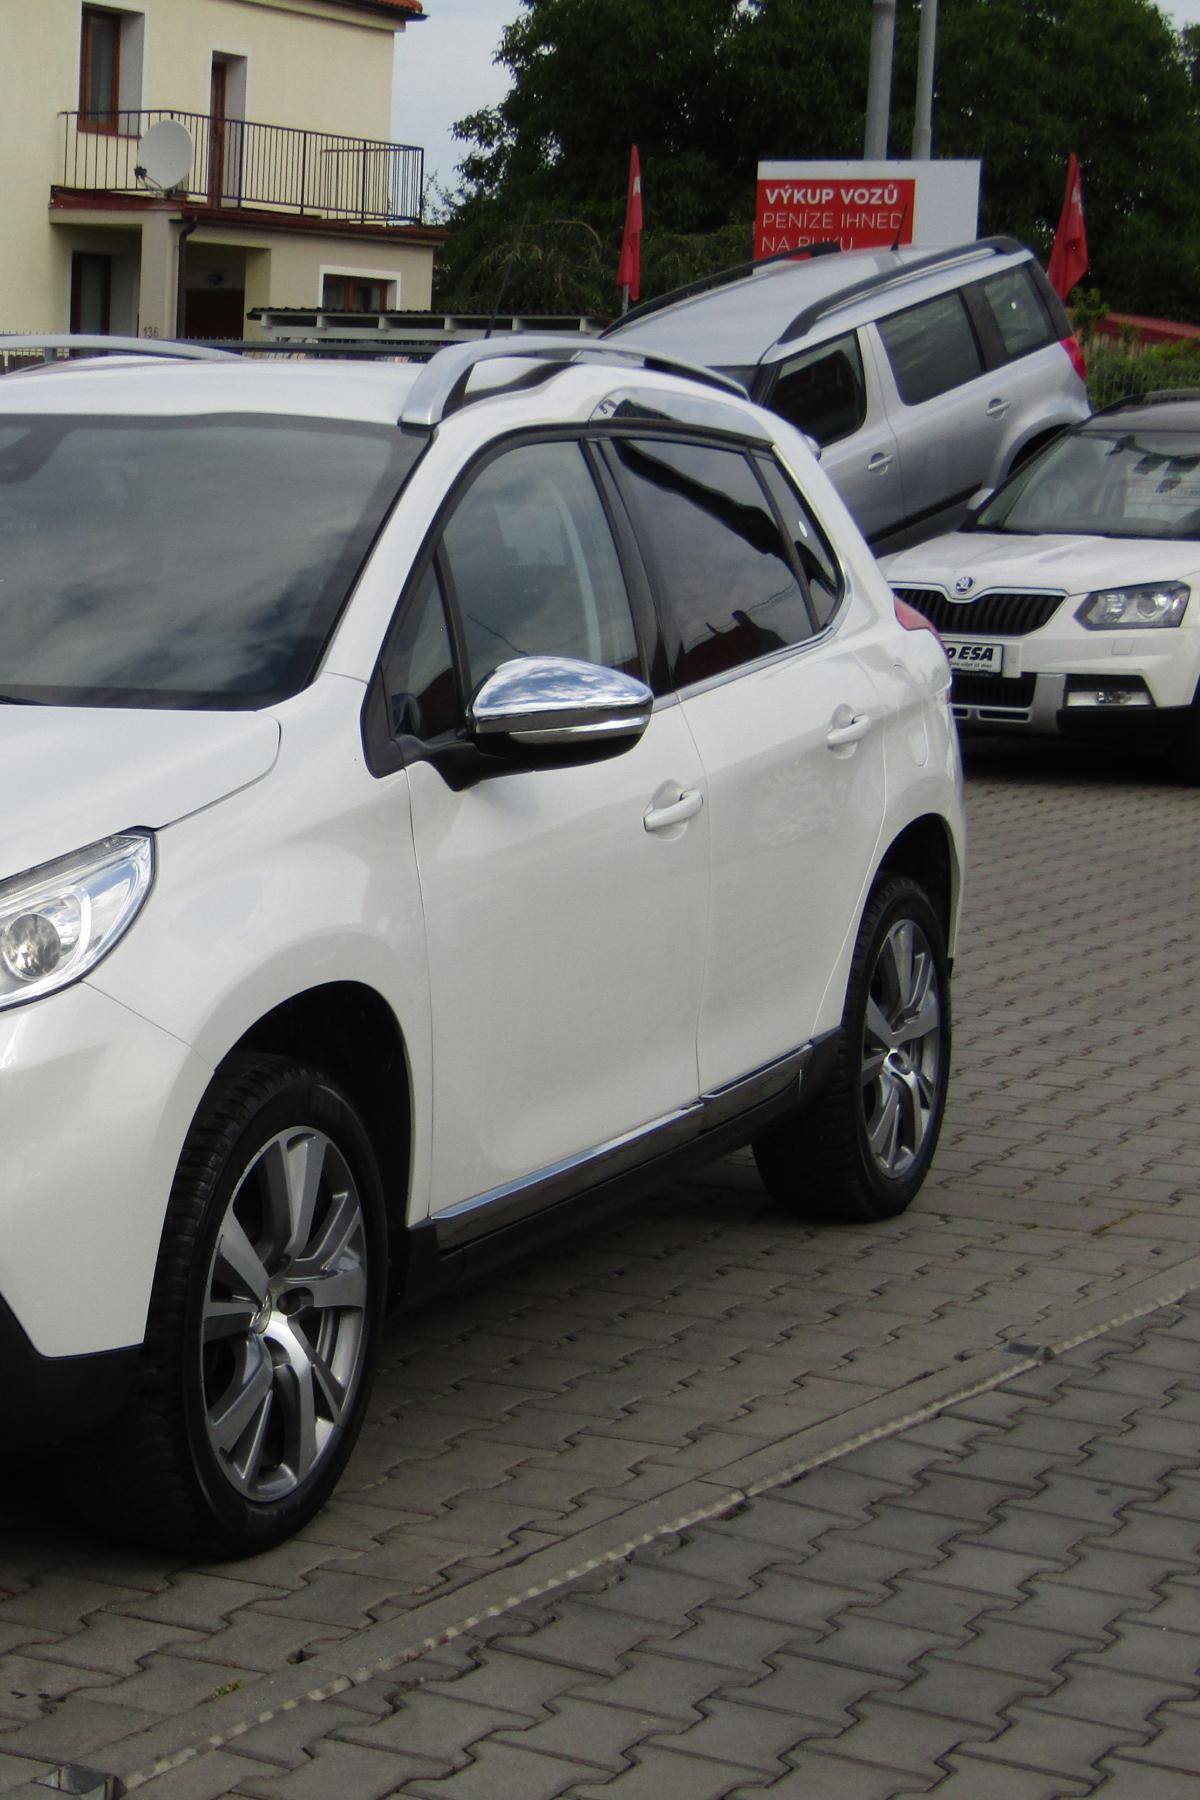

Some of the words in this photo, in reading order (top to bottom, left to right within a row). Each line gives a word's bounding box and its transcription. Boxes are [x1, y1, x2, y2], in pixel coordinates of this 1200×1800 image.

[765, 184, 834, 205] VÝKUP
[840, 183, 898, 205] VOZŮ
[762, 209, 834, 229] PENÍZE
[841, 211, 904, 229] IHNED
[761, 236, 790, 252] NA
[958, 646, 993, 661] ESA
